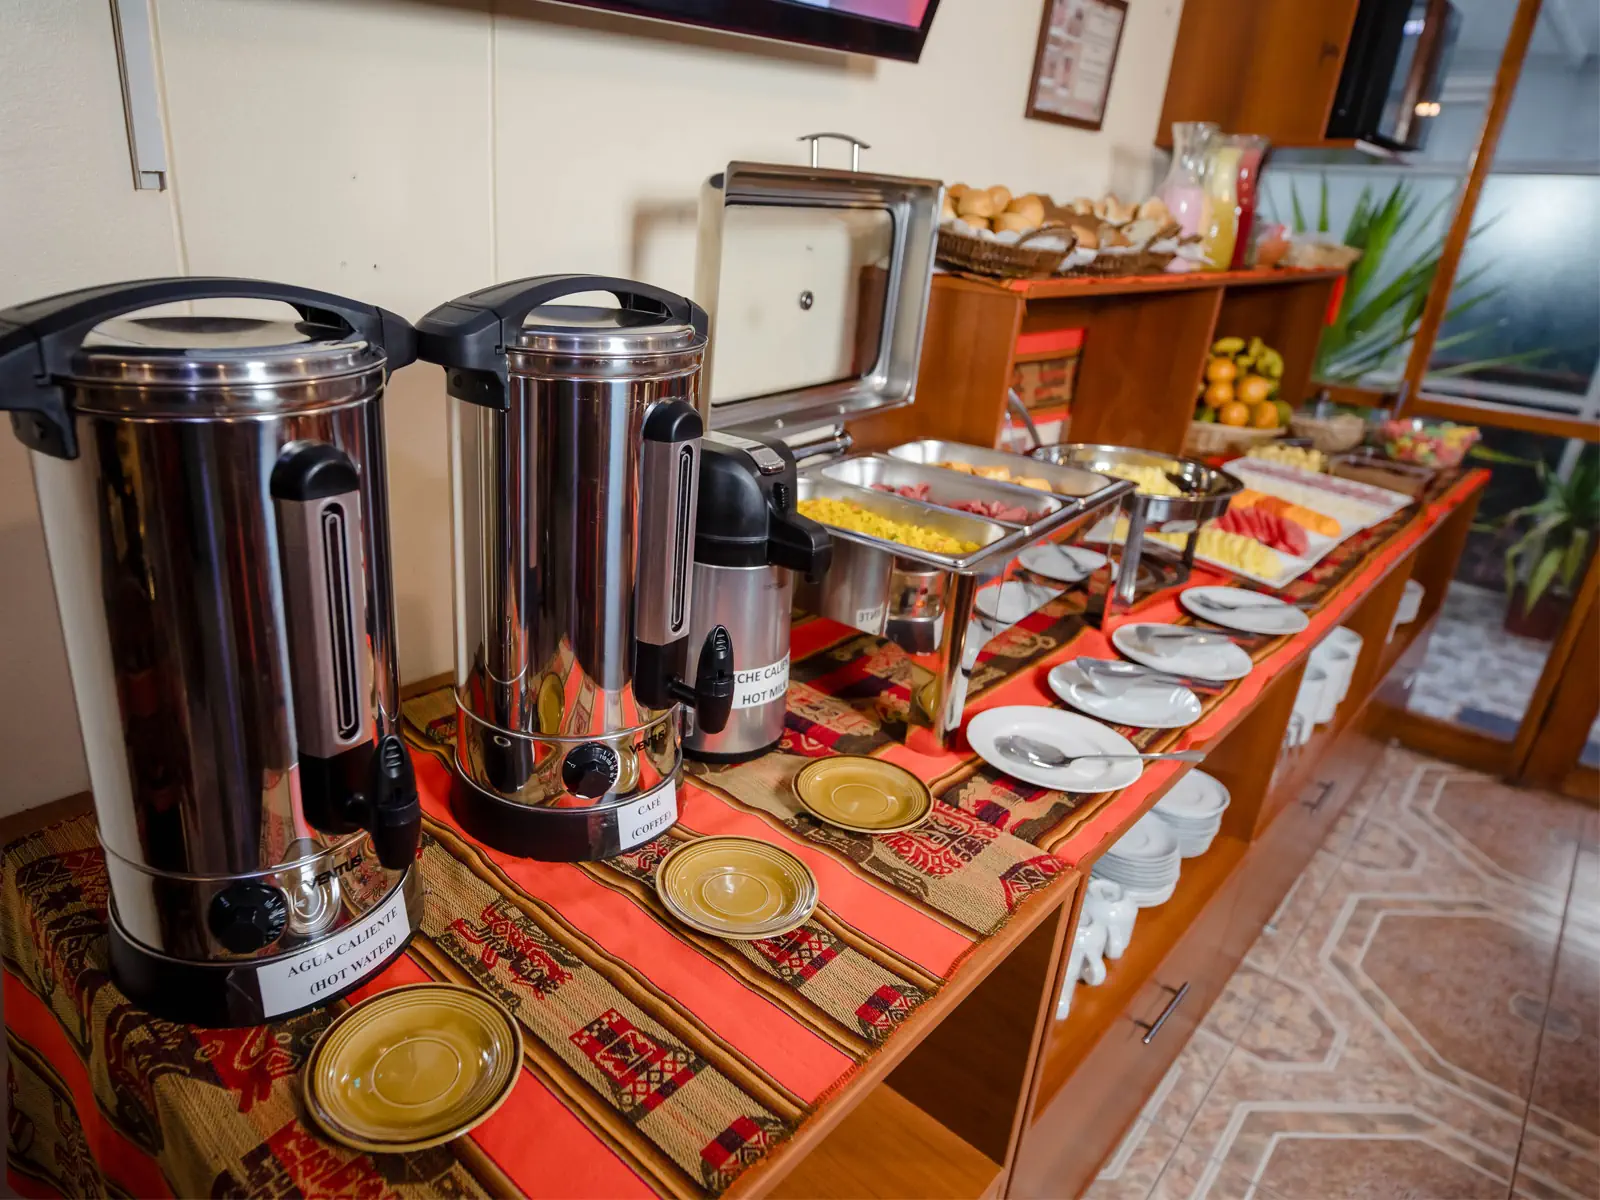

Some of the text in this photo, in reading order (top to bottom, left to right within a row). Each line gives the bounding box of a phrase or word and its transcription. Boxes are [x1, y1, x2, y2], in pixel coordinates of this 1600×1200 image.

[742, 690, 767, 705] HOT
[637, 795, 661, 815] CAFÉ
[631, 810, 672, 840] (COFFEE)
[287, 906, 398, 978] AGUA CALIENTE
[310, 934, 397, 996] (HOT WATER)
